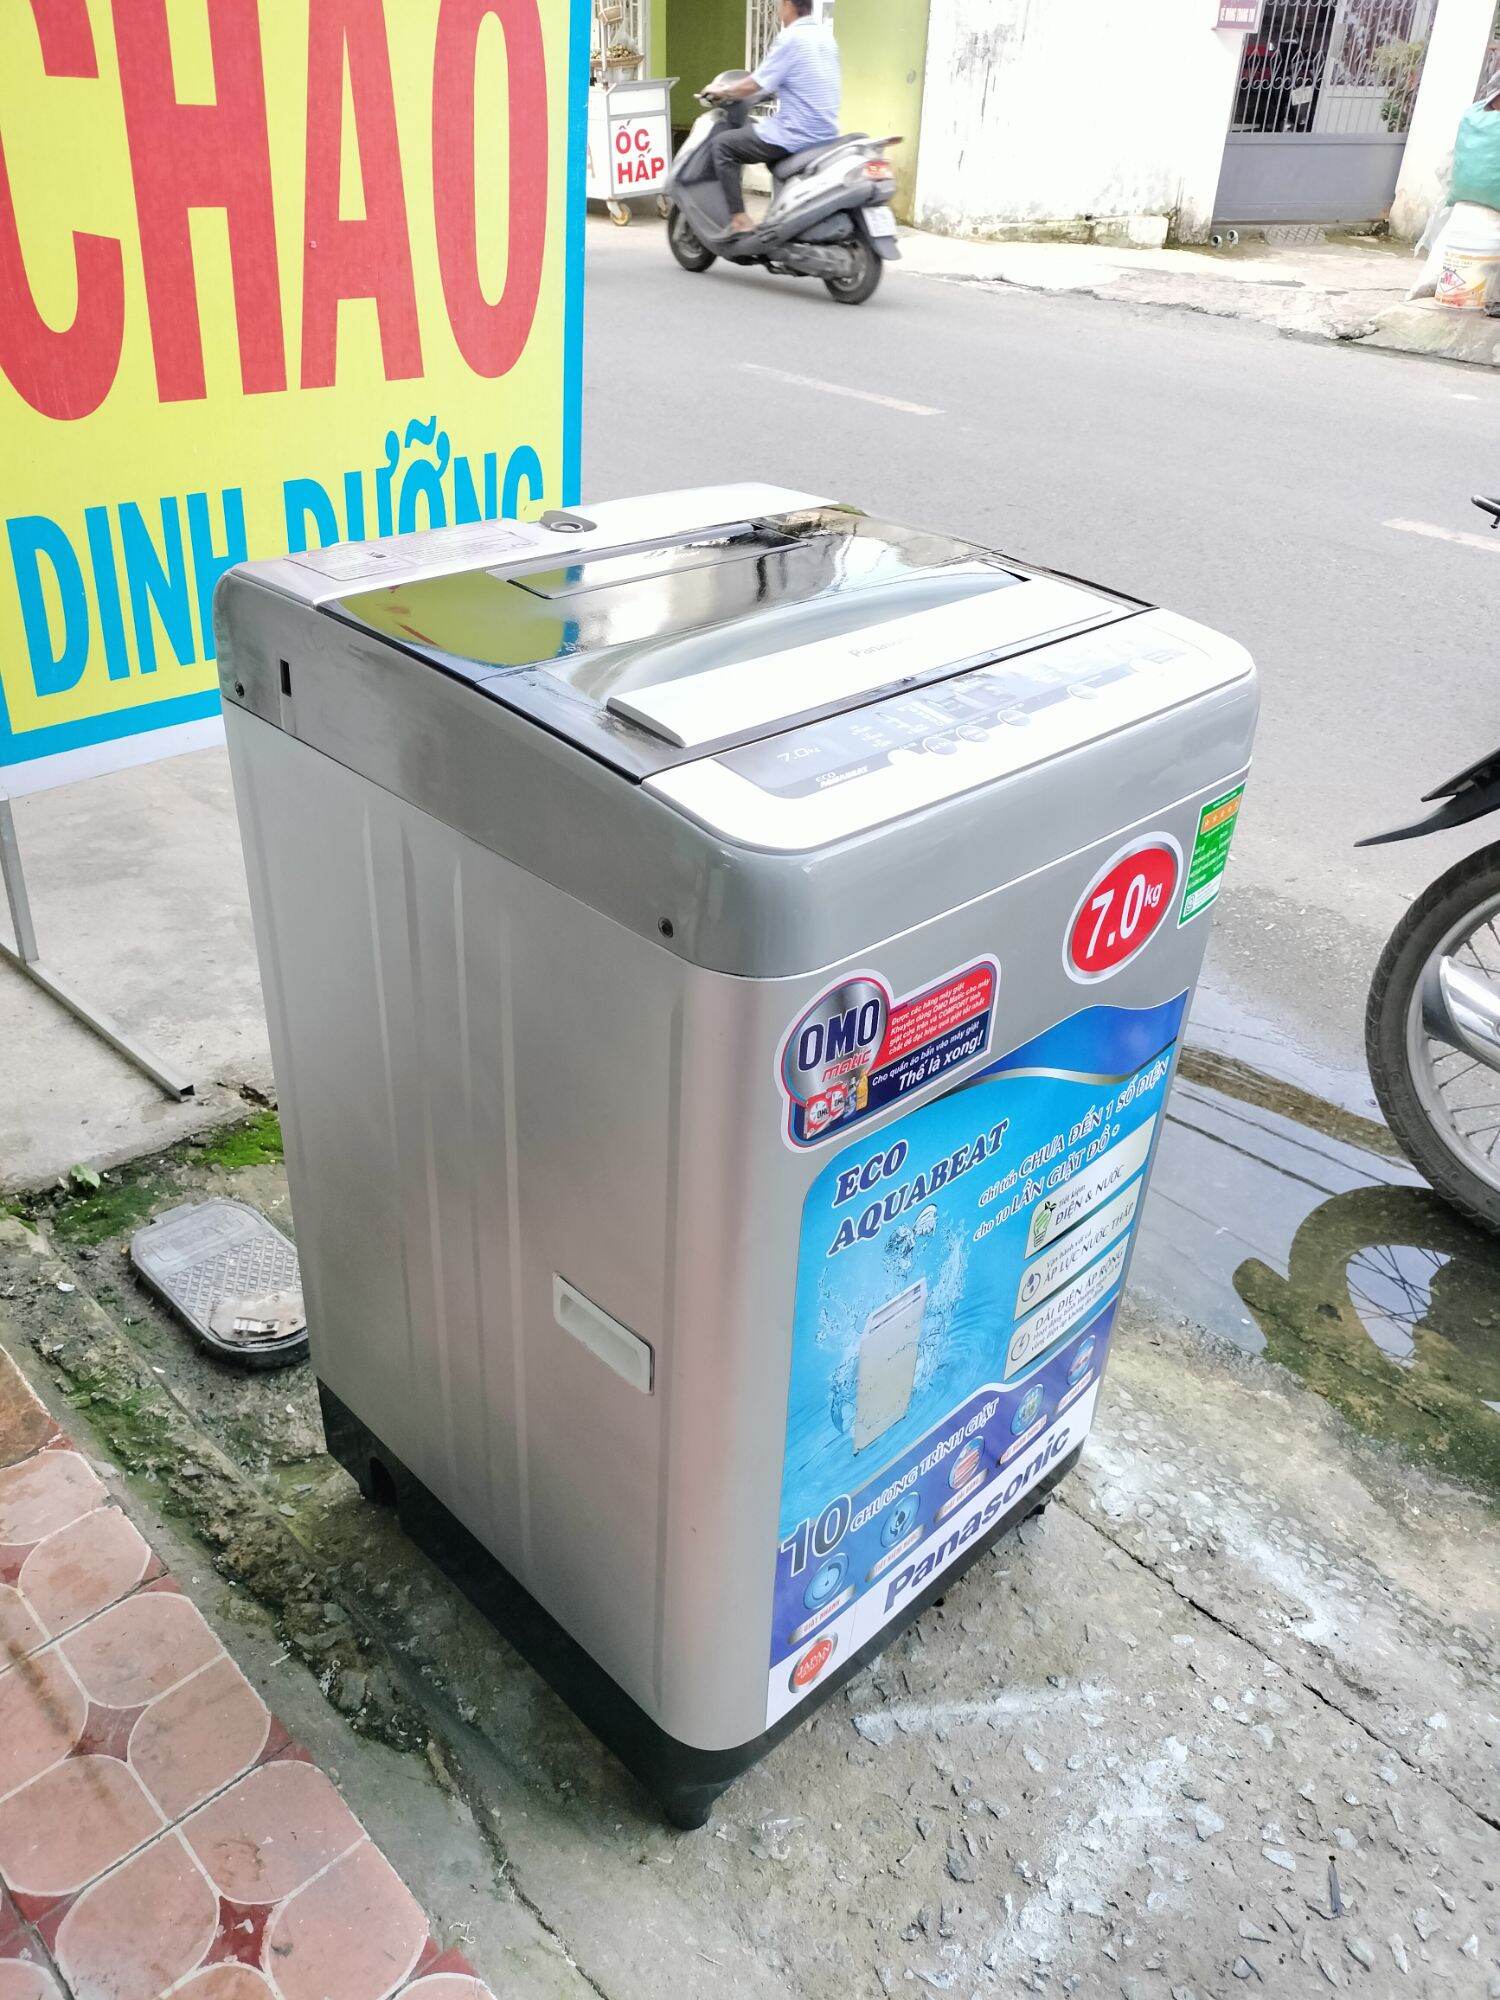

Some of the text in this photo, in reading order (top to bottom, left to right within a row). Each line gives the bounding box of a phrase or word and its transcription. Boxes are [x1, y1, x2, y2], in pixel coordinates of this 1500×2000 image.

[616, 120, 651, 155] ỐC
[617, 148, 665, 185] HẤP
[5, 488, 249, 698] DINH
[798, 998, 880, 1072] OMO
[872, 1074, 888, 1087] Cho
[890, 1061, 909, 1078] quần
[910, 1055, 920, 1067] áo
[936, 1039, 949, 1052] vào
[950, 1030, 966, 1044] máy
[965, 1020, 980, 1038] giặt
[900, 1029, 985, 1091] Thế là xong!
[1019, 1134, 1065, 1178] CHƯA
[1068, 1104, 1103, 1147] ĐẾN
[1104, 1099, 1114, 1121] 1
[1116, 1075, 1138, 1114] SỐ
[1135, 1056, 1170, 1097] ĐIỆN
[827, 1119, 1009, 1257] AQUABEAT
[833, 1140, 907, 1207] ECO
[973, 1124, 1111, 1242] cho 10 LẦN GIẶT ĐỒ
[1056, 1163, 1125, 1226] ĐIỆN & NƯỚC
[1044, 1262, 1058, 1285] ÁP
[1059, 1248, 1081, 1274] LỰC
[1082, 1225, 1110, 1255] NƯỚC
[1111, 1201, 1134, 1230] THẤP
[1058, 1284, 1083, 1313] ĐIỆN
[781, 1494, 851, 1577] 10
[850, 1465, 919, 1532] CHƯƠNG
[919, 1426, 965, 1476] TRÌNH
[964, 1397, 1000, 1438] GIẶT
[883, 1427, 1071, 1615] Panasonic
